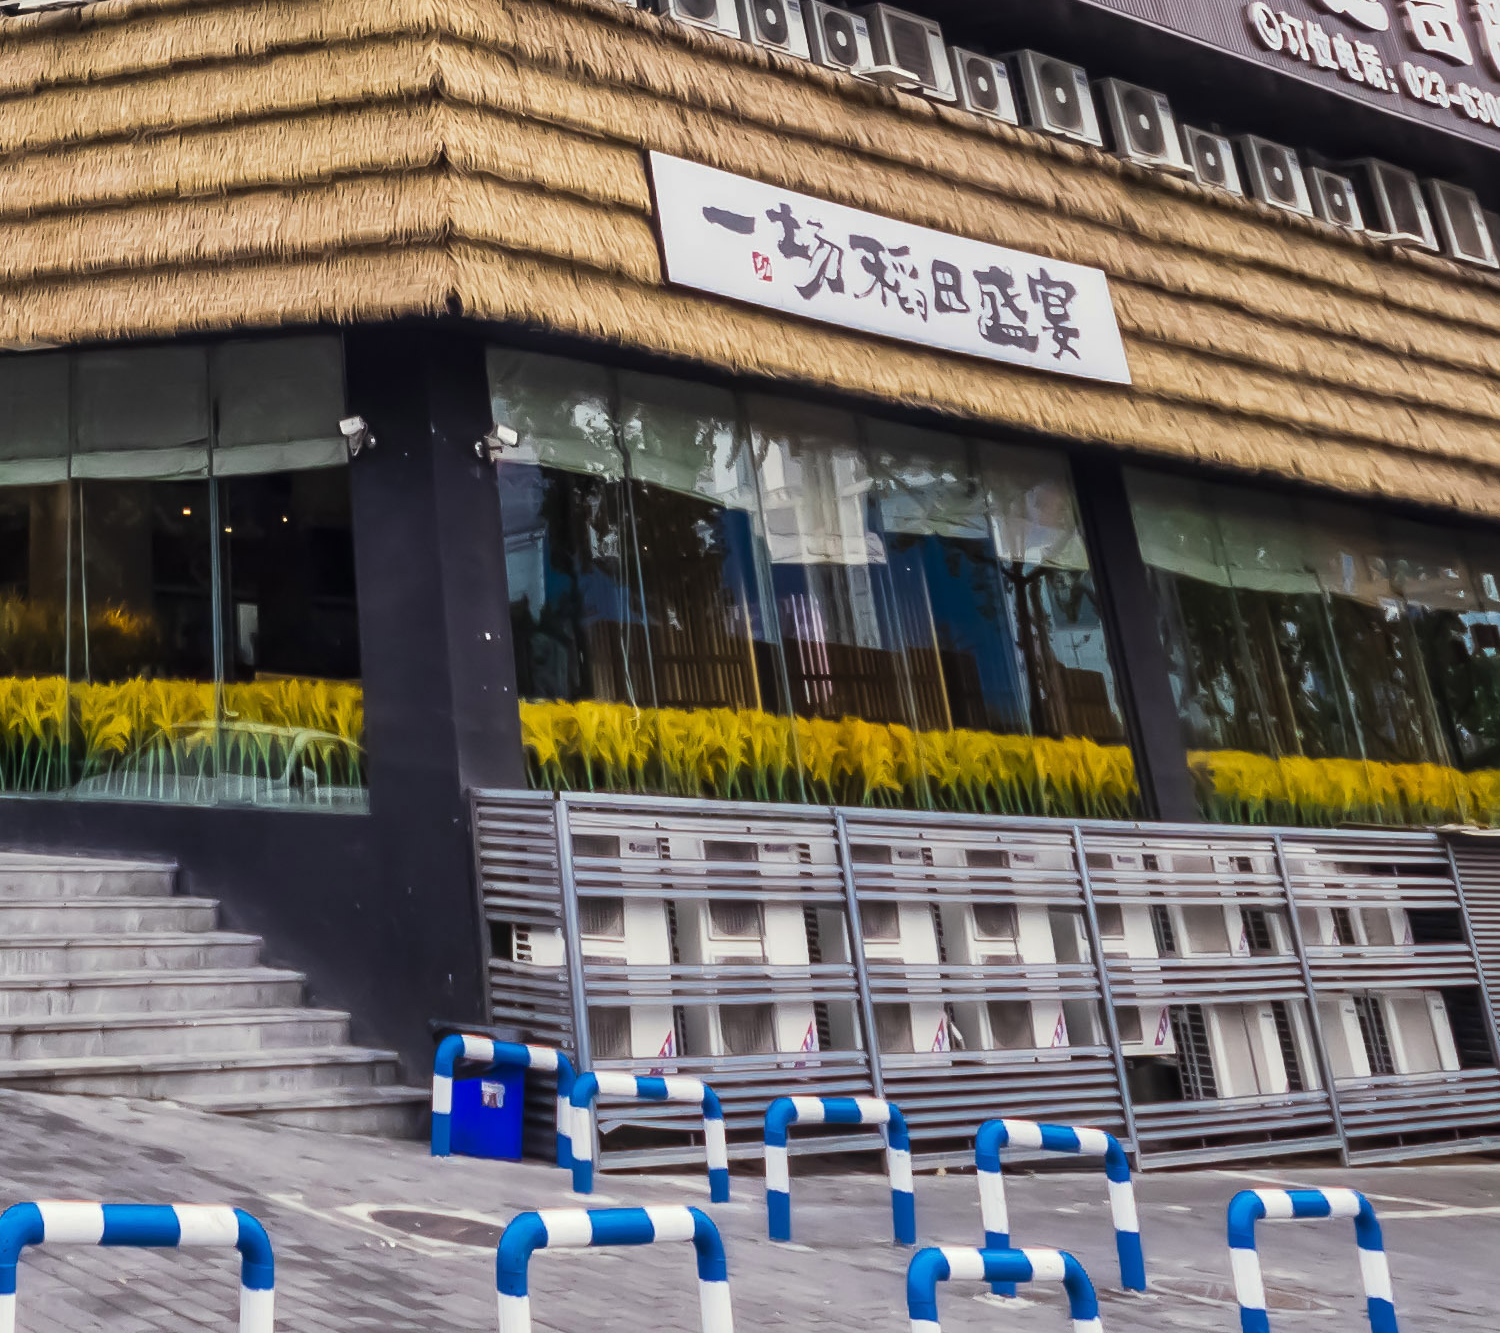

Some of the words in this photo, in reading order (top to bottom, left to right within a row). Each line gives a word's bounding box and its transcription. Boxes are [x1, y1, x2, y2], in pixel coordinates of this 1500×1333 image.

[702, 202, 1082, 361] 一场稻田盛宴
